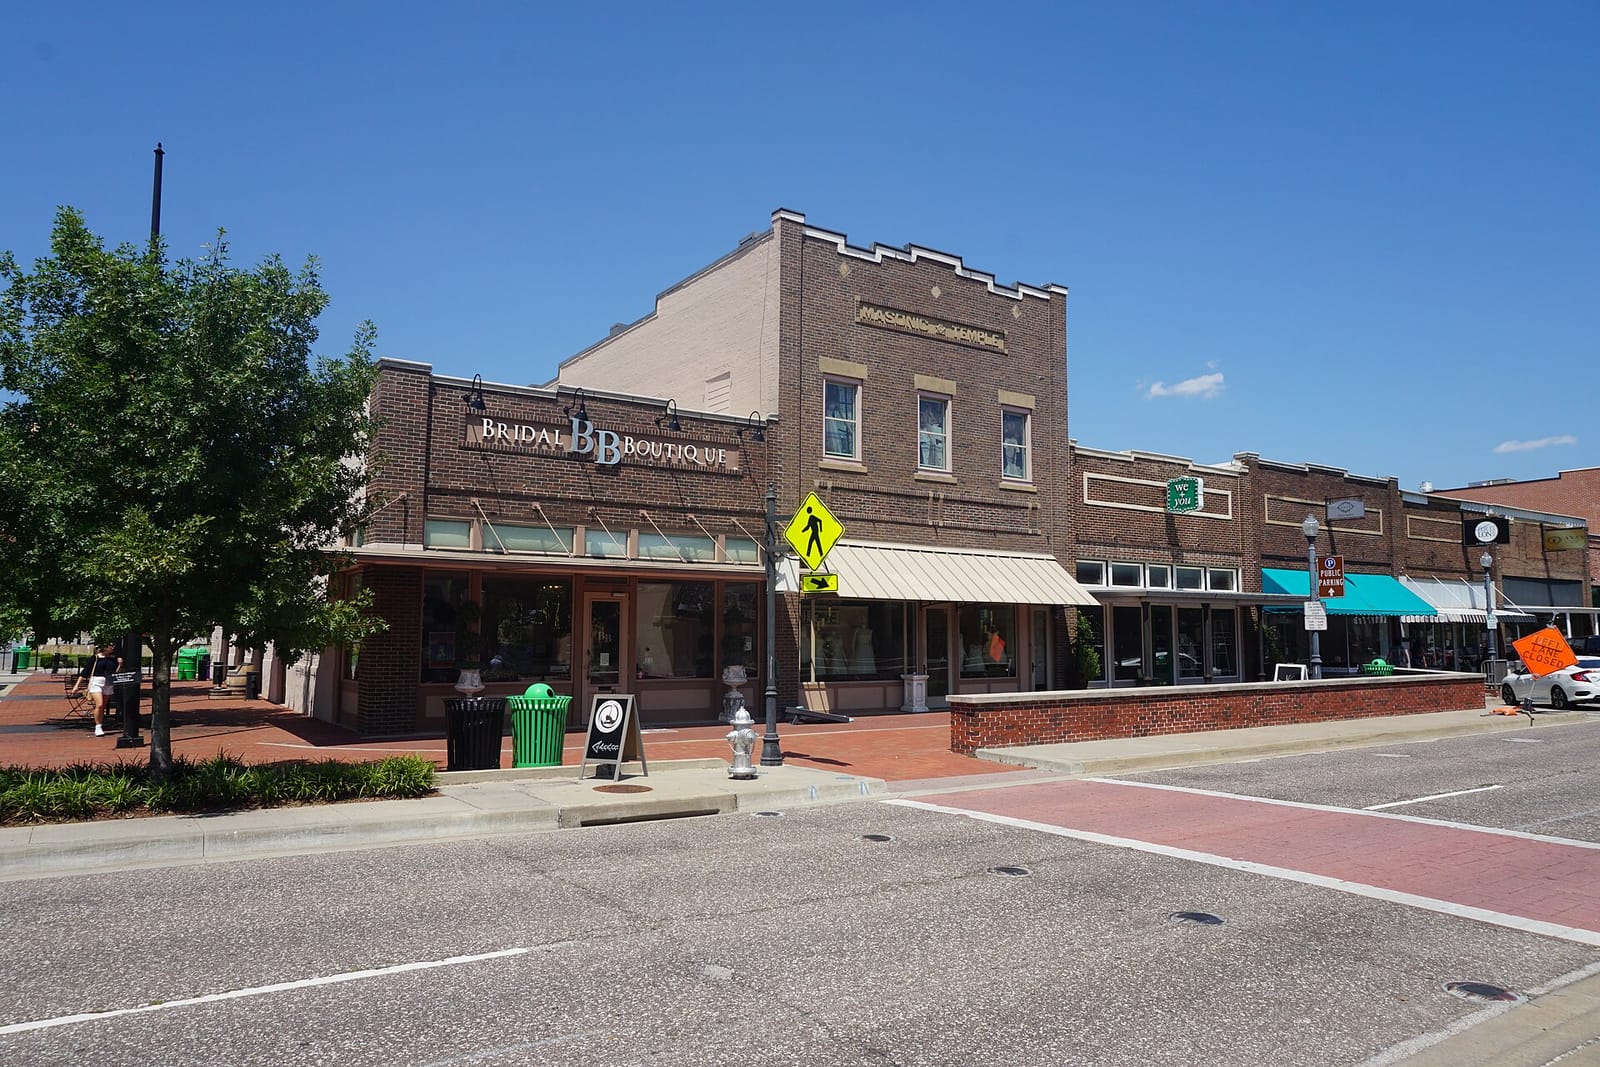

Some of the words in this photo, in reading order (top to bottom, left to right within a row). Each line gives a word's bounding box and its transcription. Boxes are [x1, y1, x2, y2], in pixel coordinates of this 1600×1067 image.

[859, 306, 929, 332] MASONIC
[951, 325, 1000, 348] TEMPLE
[481, 418, 563, 445] BRIDAL
[569, 417, 621, 465] BB
[623, 436, 726, 464] BOUTIQUE
[1175, 484, 1189, 492] we
[1173, 497, 1191, 508] you
[1320, 569, 1341, 577] PUBLIC
[1318, 578, 1344, 587] PARKING
[1534, 636, 1561, 649] LEFT
[1531, 645, 1560, 658] LANE
[1522, 650, 1564, 669] CLOSED
